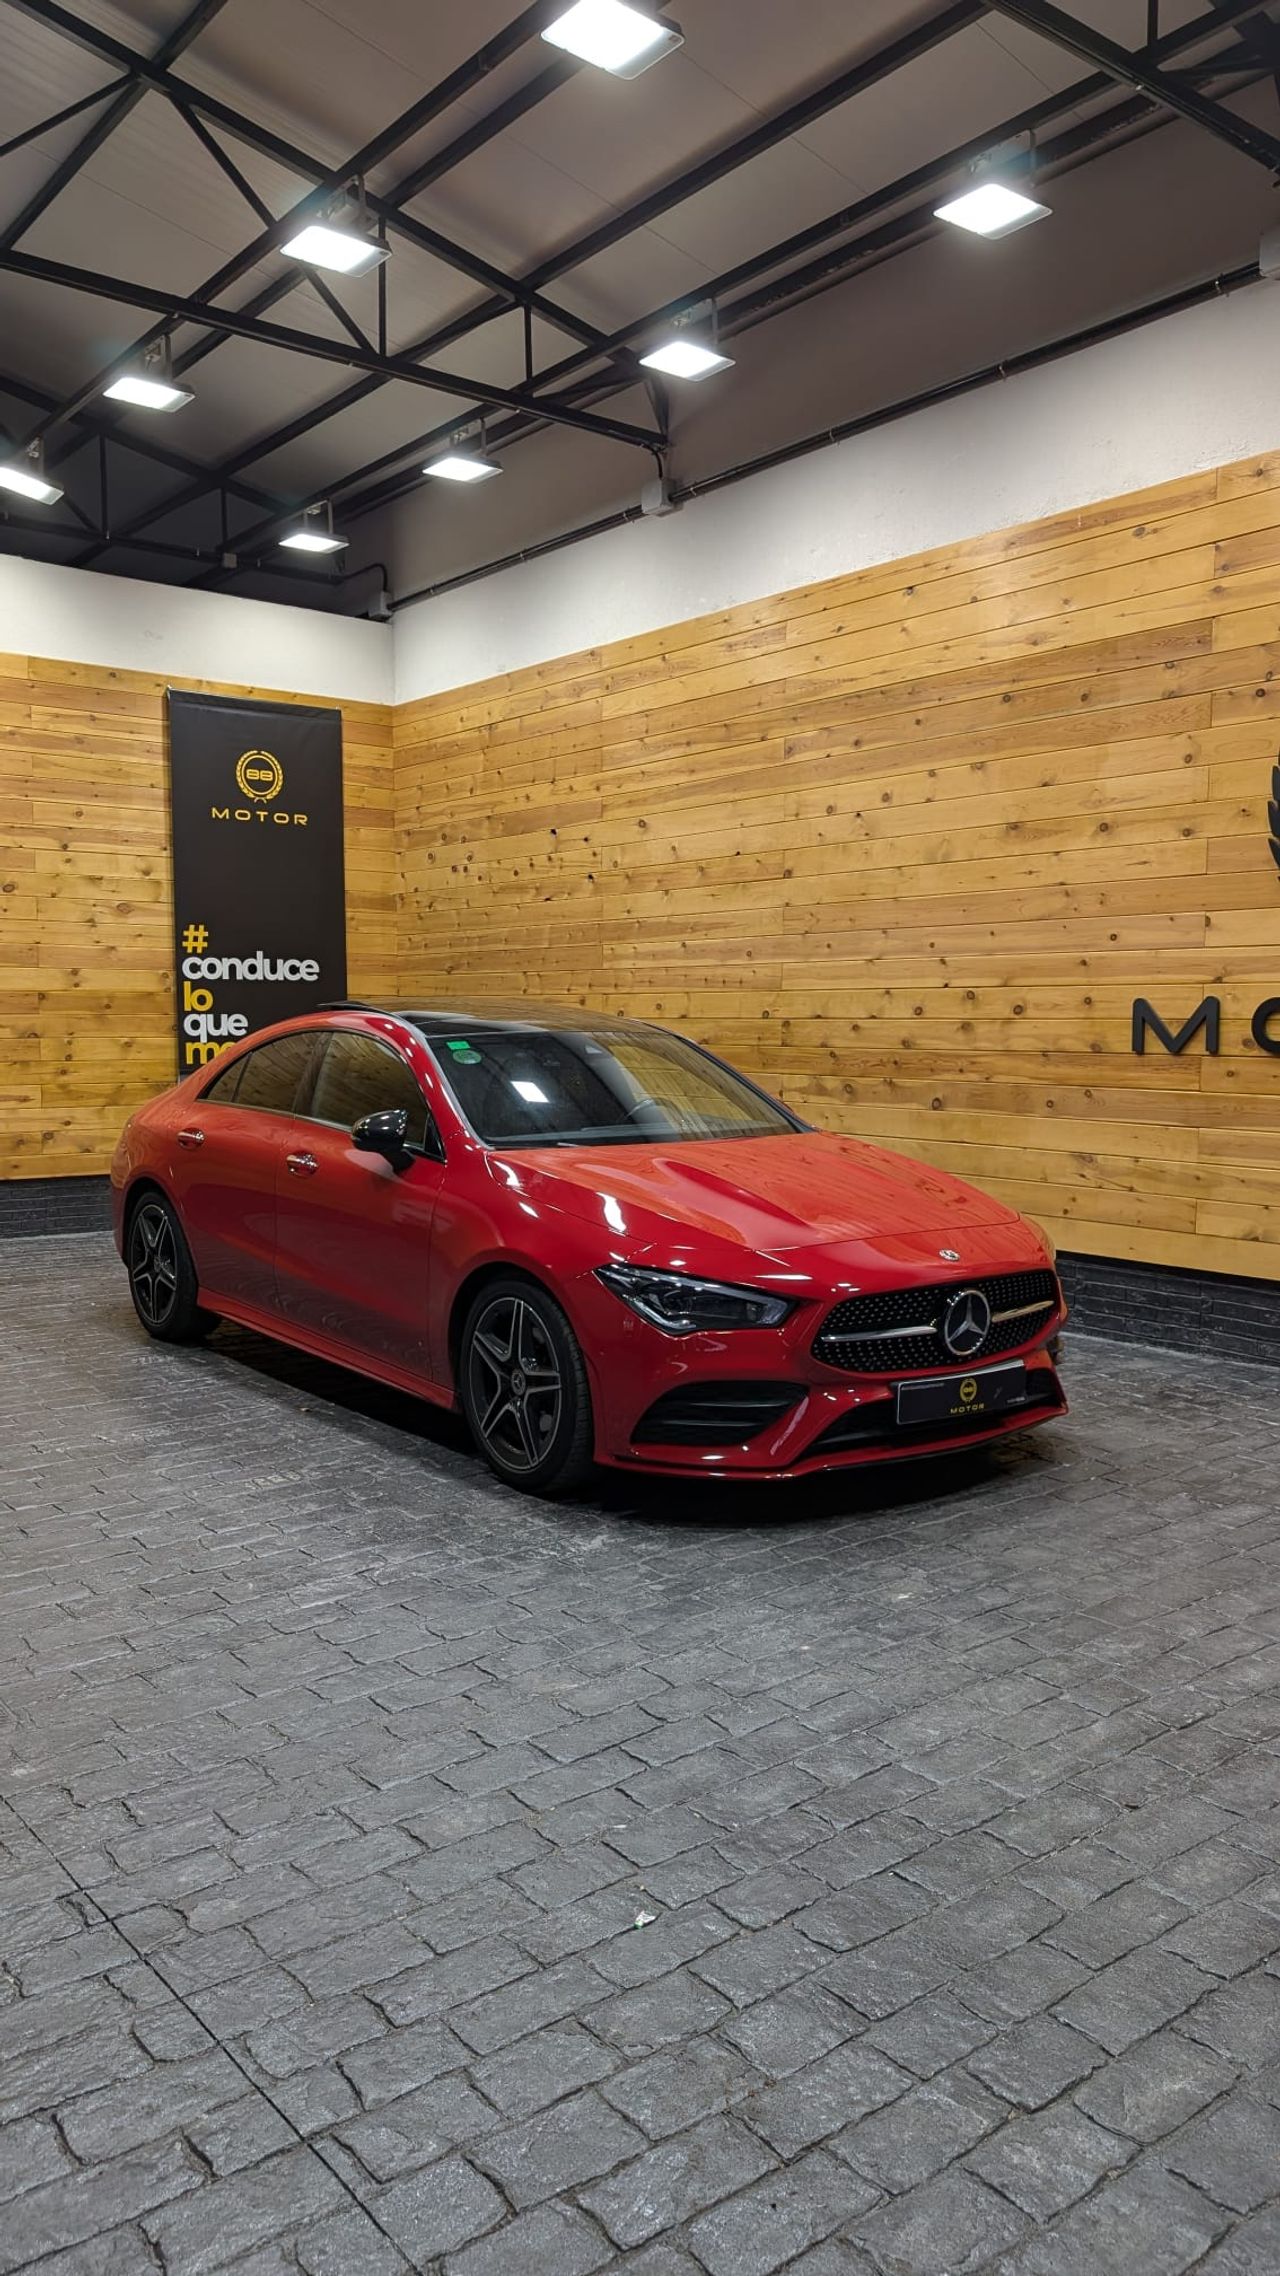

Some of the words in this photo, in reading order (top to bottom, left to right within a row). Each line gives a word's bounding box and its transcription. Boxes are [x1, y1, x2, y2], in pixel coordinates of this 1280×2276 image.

[211, 807, 308, 826] MOTOR
[182, 924, 209, 953] #
[182, 951, 320, 981] conduce
[183, 981, 214, 1012] lo
[183, 1013, 249, 1043] que
[950, 1403, 985, 1414] MOTOR
